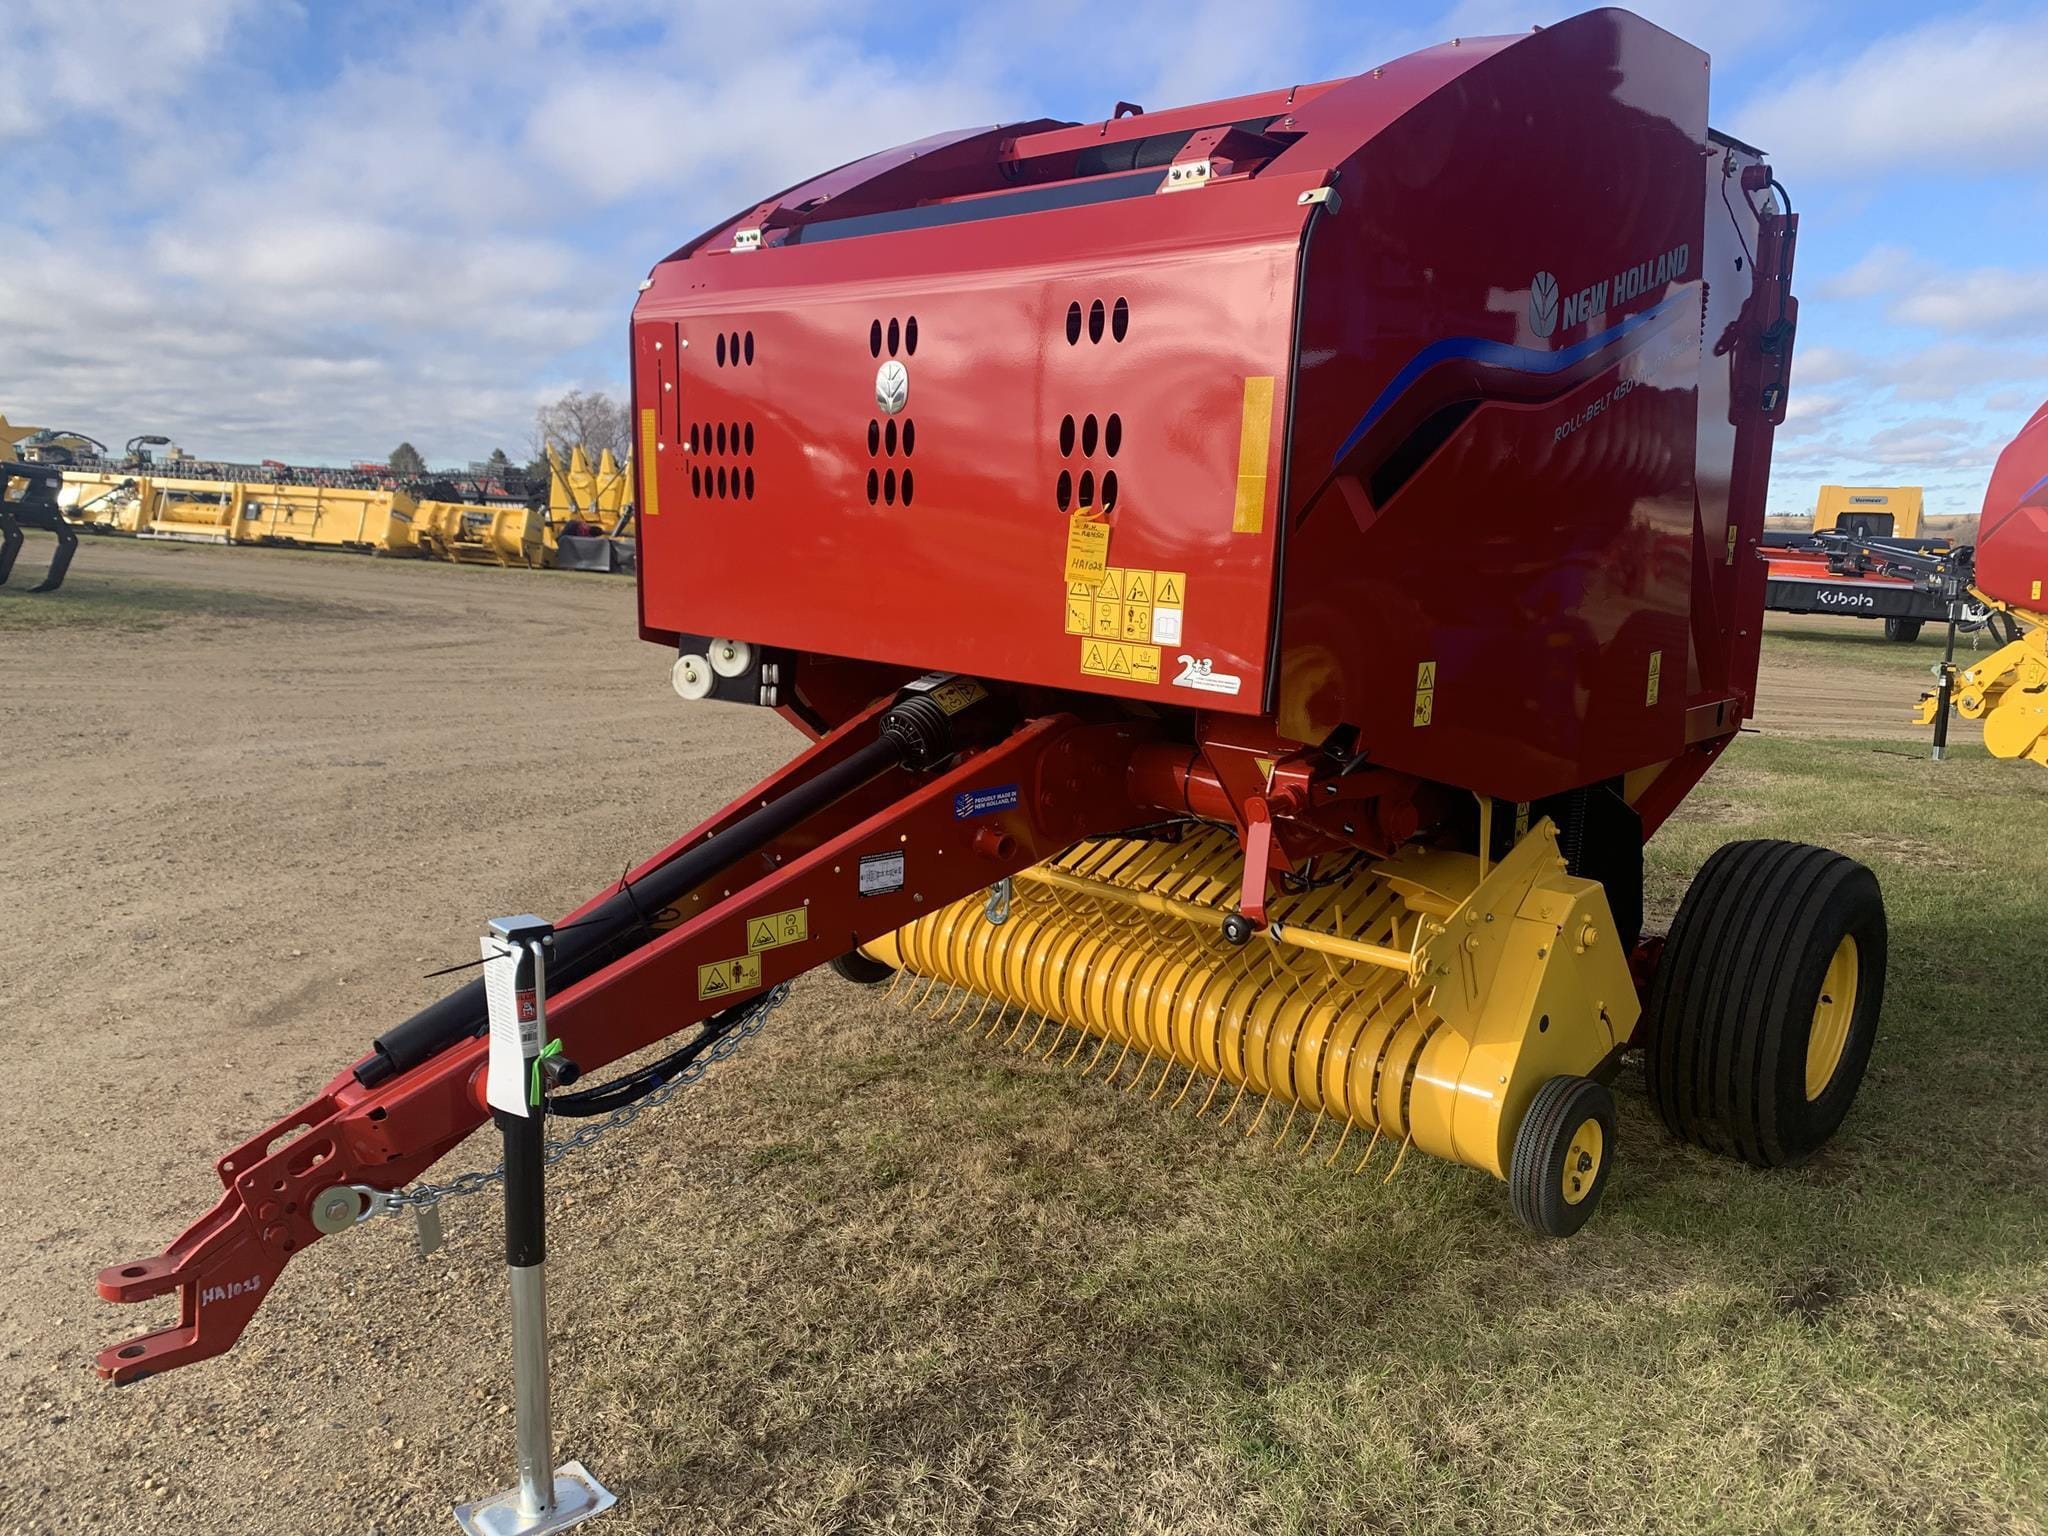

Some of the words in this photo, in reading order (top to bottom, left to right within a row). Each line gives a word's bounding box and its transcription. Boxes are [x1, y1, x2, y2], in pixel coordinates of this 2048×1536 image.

[1562, 280, 1609, 331] NEW
[1612, 243, 1689, 307] HOLLAND
[1554, 391, 1612, 443] ROLL-BELT
[1613, 378, 1633, 400] 450
[1071, 557, 1103, 571] HA1028
[1816, 590, 1874, 607] Kubota
[975, 795, 996, 804] PROUDLY
[997, 792, 1011, 800] MADE
